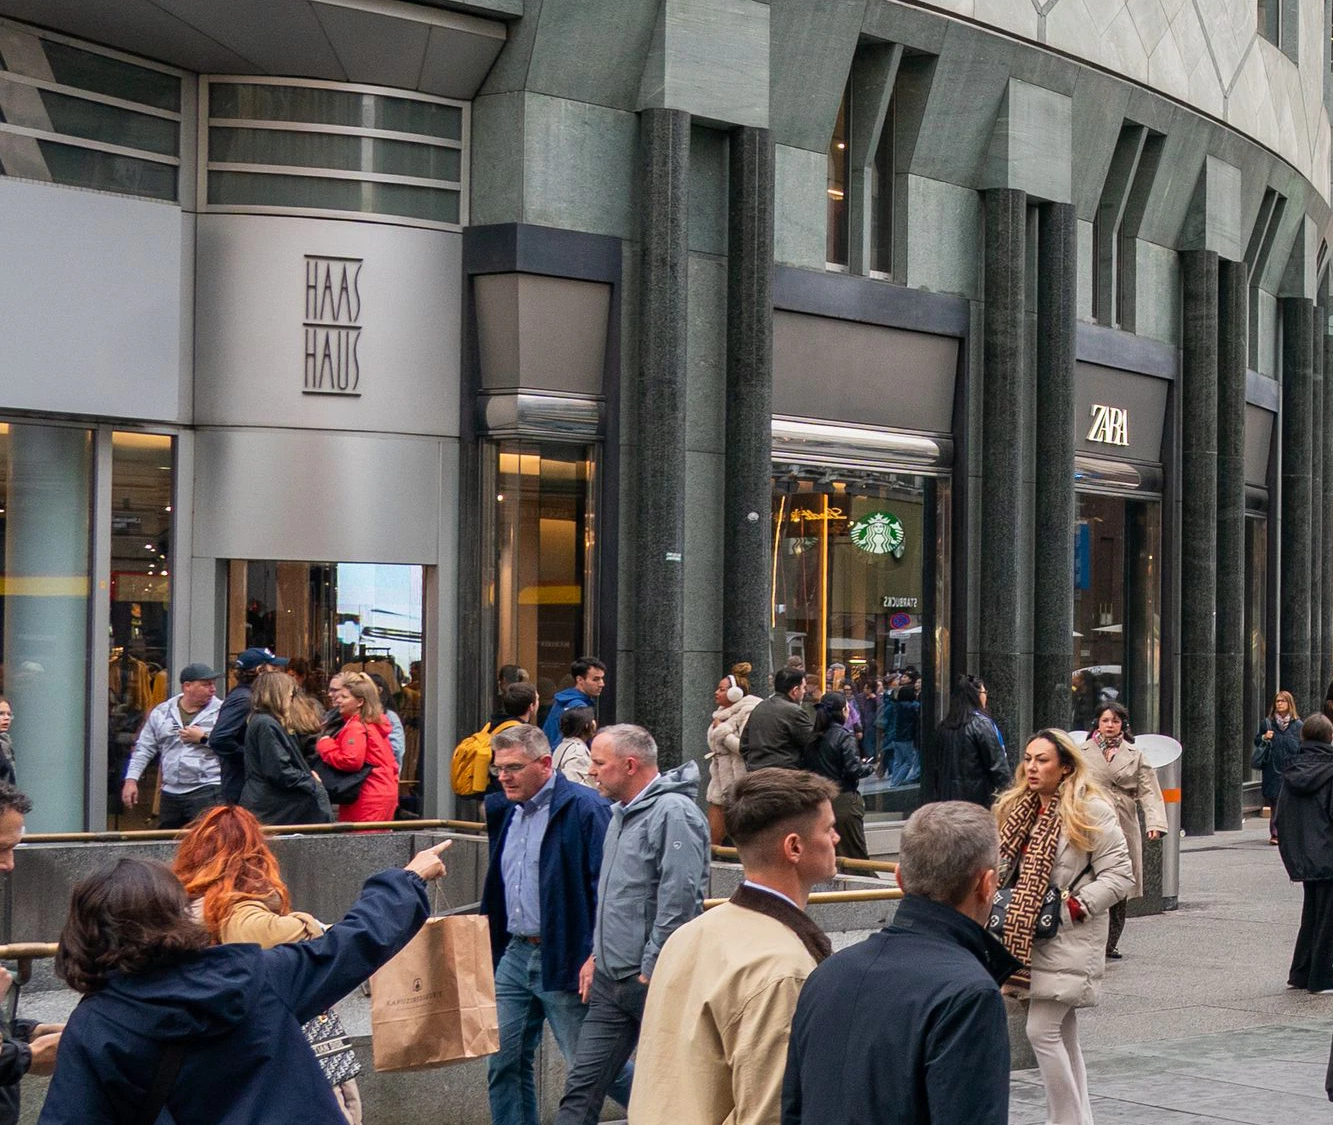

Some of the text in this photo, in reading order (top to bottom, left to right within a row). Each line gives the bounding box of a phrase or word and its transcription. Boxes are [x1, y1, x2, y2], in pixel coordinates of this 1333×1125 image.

[305, 260, 362, 322] HAAS
[304, 328, 361, 391] HAUS
[1086, 404, 1130, 446] ZARA
